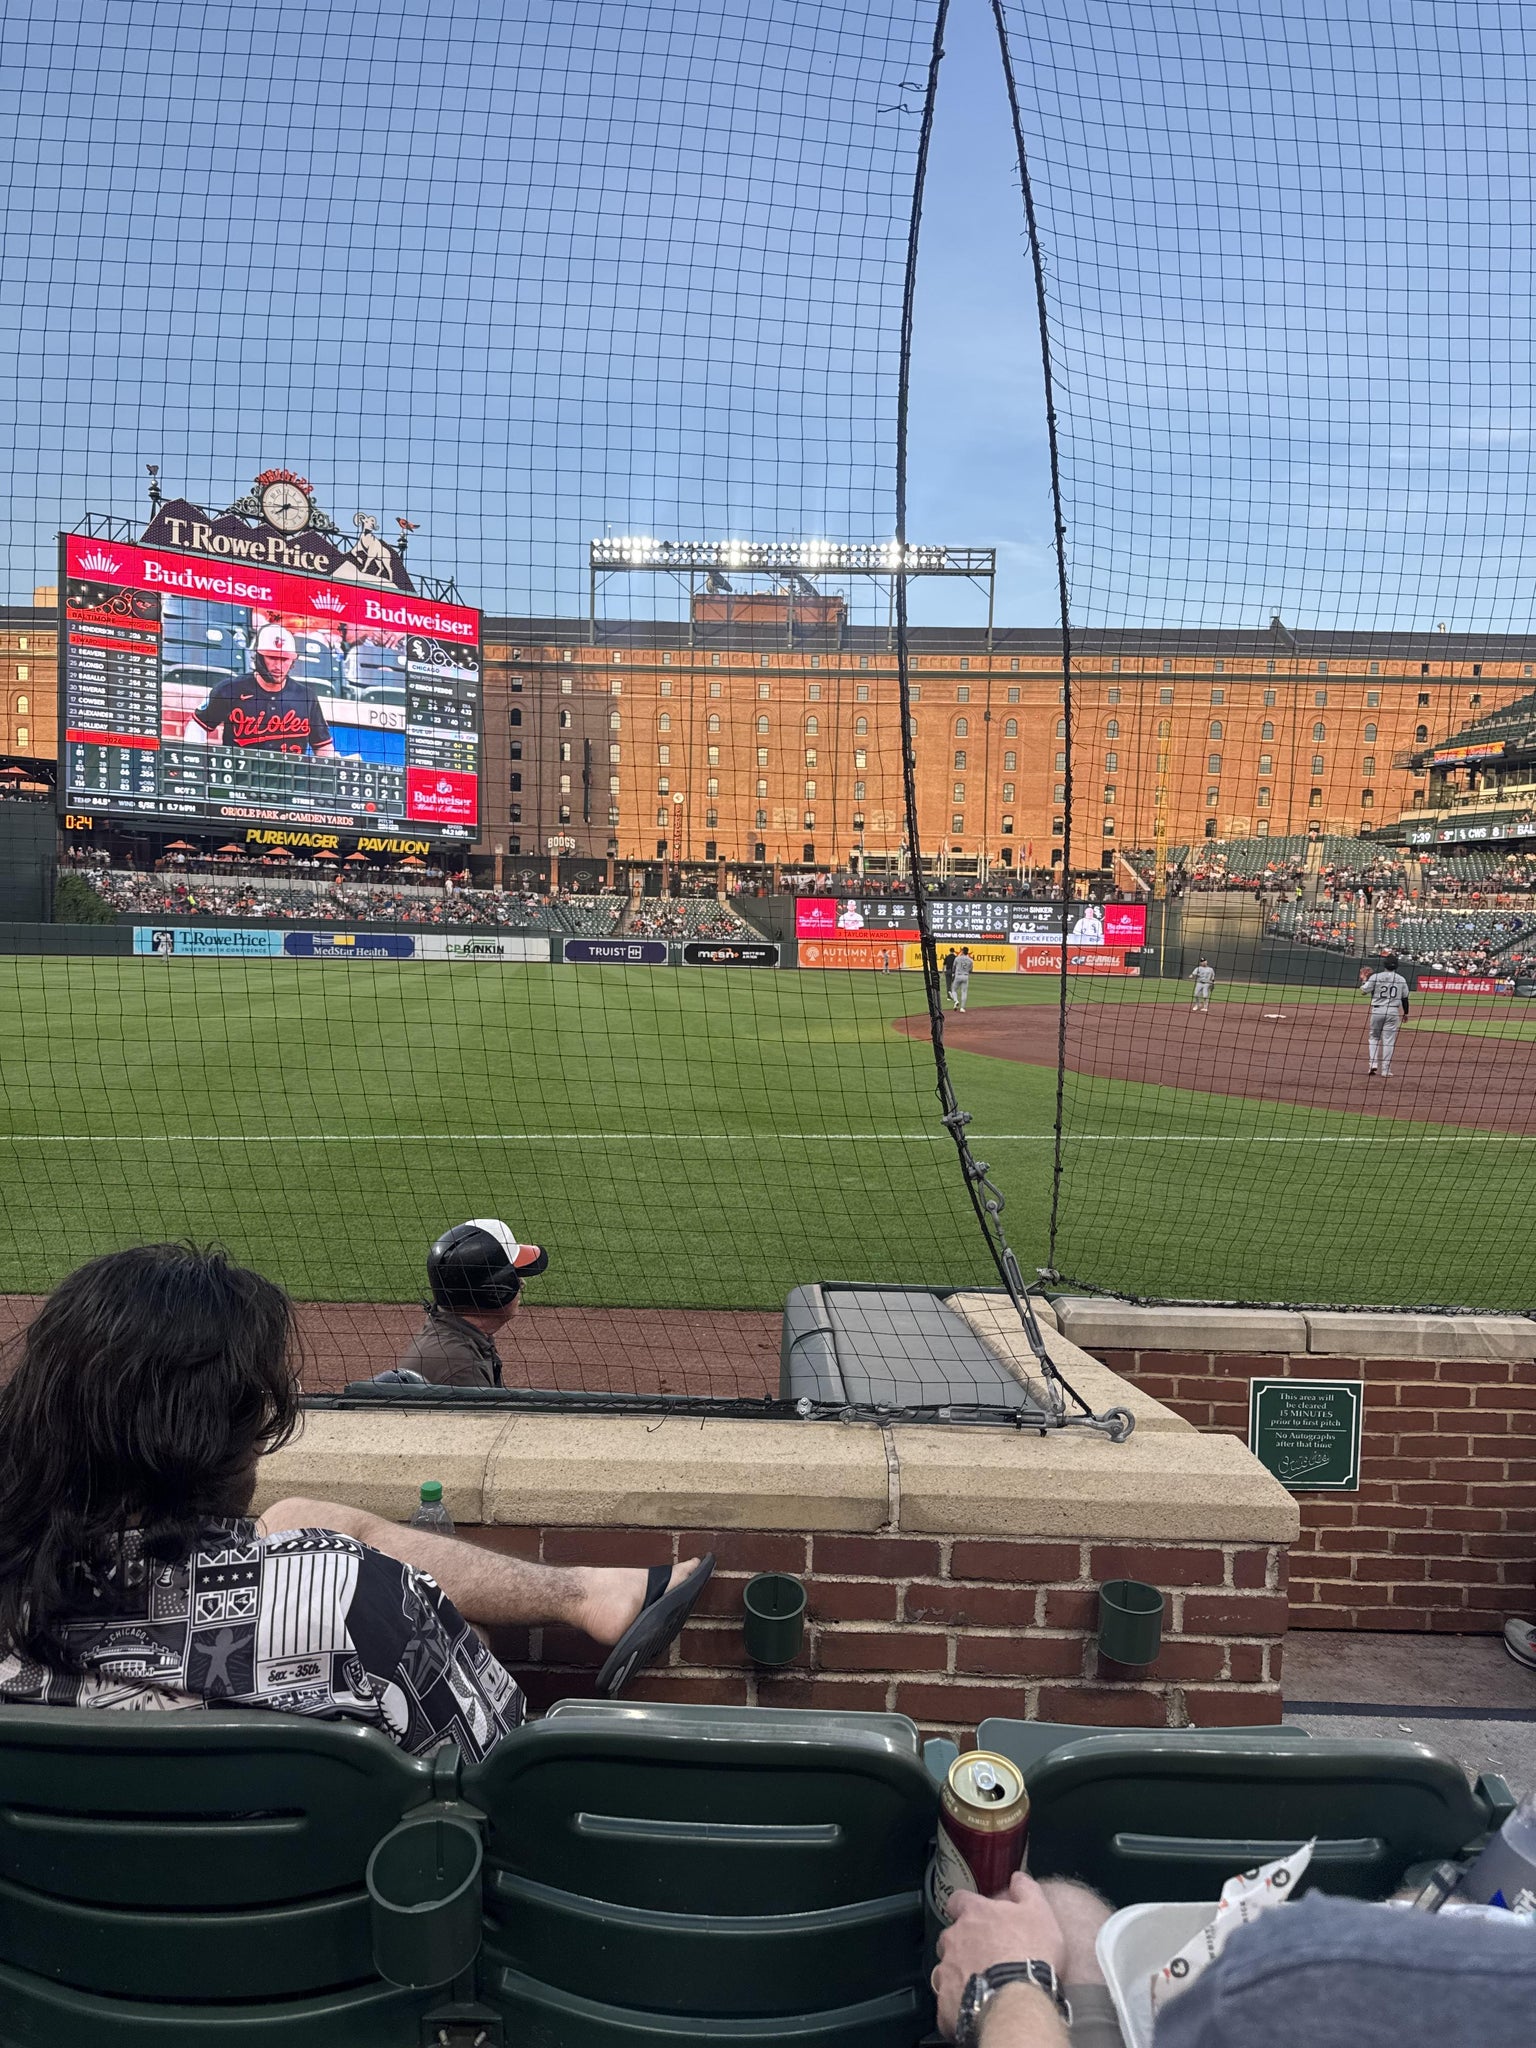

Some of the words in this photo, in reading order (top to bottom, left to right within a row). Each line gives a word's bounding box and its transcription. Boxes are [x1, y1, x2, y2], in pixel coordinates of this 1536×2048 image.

[143, 560, 271, 601] Budweiser
[72, 612, 117, 623] BALTIMORE
[365, 599, 473, 636] Budweiser
[79, 625, 114, 636] HENDERSON
[79, 648, 106, 657] BEAVERS
[79, 661, 104, 670] ALONSO
[412, 664, 440, 674] CHICAGO
[79, 673, 106, 682] BASALLO
[79, 685, 106, 694] TAVERAS
[78, 697, 105, 706] COWSER
[78, 709, 113, 719] ALEXANDER
[229, 708, 311, 738] Orioles
[369, 711, 406, 729] POST
[78, 722, 108, 730] HOLLIDAY
[183, 756, 200, 764] CWS
[211, 758, 217, 767] 1
[224, 759, 232, 768] 0
[238, 760, 246, 770] 7
[340, 771, 347, 780] 8
[353, 772, 359, 781] 7
[365, 773, 372, 783] 0
[381, 776, 388, 785] 4
[394, 777, 400, 785] 1
[183, 771, 197, 779] BAL
[211, 773, 217, 782] 1
[224, 774, 232, 784] 0
[341, 785, 346, 795] 1
[352, 787, 360, 796] 2
[365, 788, 372, 797] 0
[381, 790, 388, 799] 2
[394, 790, 400, 799] 1
[229, 791, 247, 799] BALL
[413, 791, 472, 806] Budweiser
[138, 801, 155, 809] S/SE
[221, 806, 255, 818] ORIOLE
[256, 808, 278, 820] PARK
[289, 812, 327, 824] CAMDEN
[326, 814, 354, 826] YARDS
[65, 815, 93, 830] 0:24
[1468, 828, 1487, 838] CWS
[1492, 827, 1500, 836] 8
[1517, 824, 1536, 835] BAL
[246, 829, 339, 849] PUREWAGER
[357, 837, 430, 855] PAVILION
[1411, 833, 1431, 843] 7:39
[1012, 923, 1036, 932] 94.2
[313, 947, 354, 956] MedStar
[356, 948, 389, 956] Health
[588, 947, 627, 956] TRUIST
[823, 948, 867, 957] AUTUMN
[1027, 956, 1062, 969] HIGH'S
[1420, 979, 1443, 989] weis
[1445, 979, 1490, 991] markets
[1380, 985, 1398, 999] 20
[1290, 1410, 1333, 1418] MINUTES
[1271, 1419, 1291, 1427] prior
[1293, 1419, 1301, 1427] to
[1320, 1419, 1341, 1428] pitch
[1290, 1432, 1336, 1441] Autographs
[1314, 1441, 1333, 1449] time
[110, 1628, 147, 1641] CHICAGO
[267, 1669, 287, 1682] Sox
[295, 1662, 321, 1678] 35th
[968, 1815, 990, 1826] FAMILY
